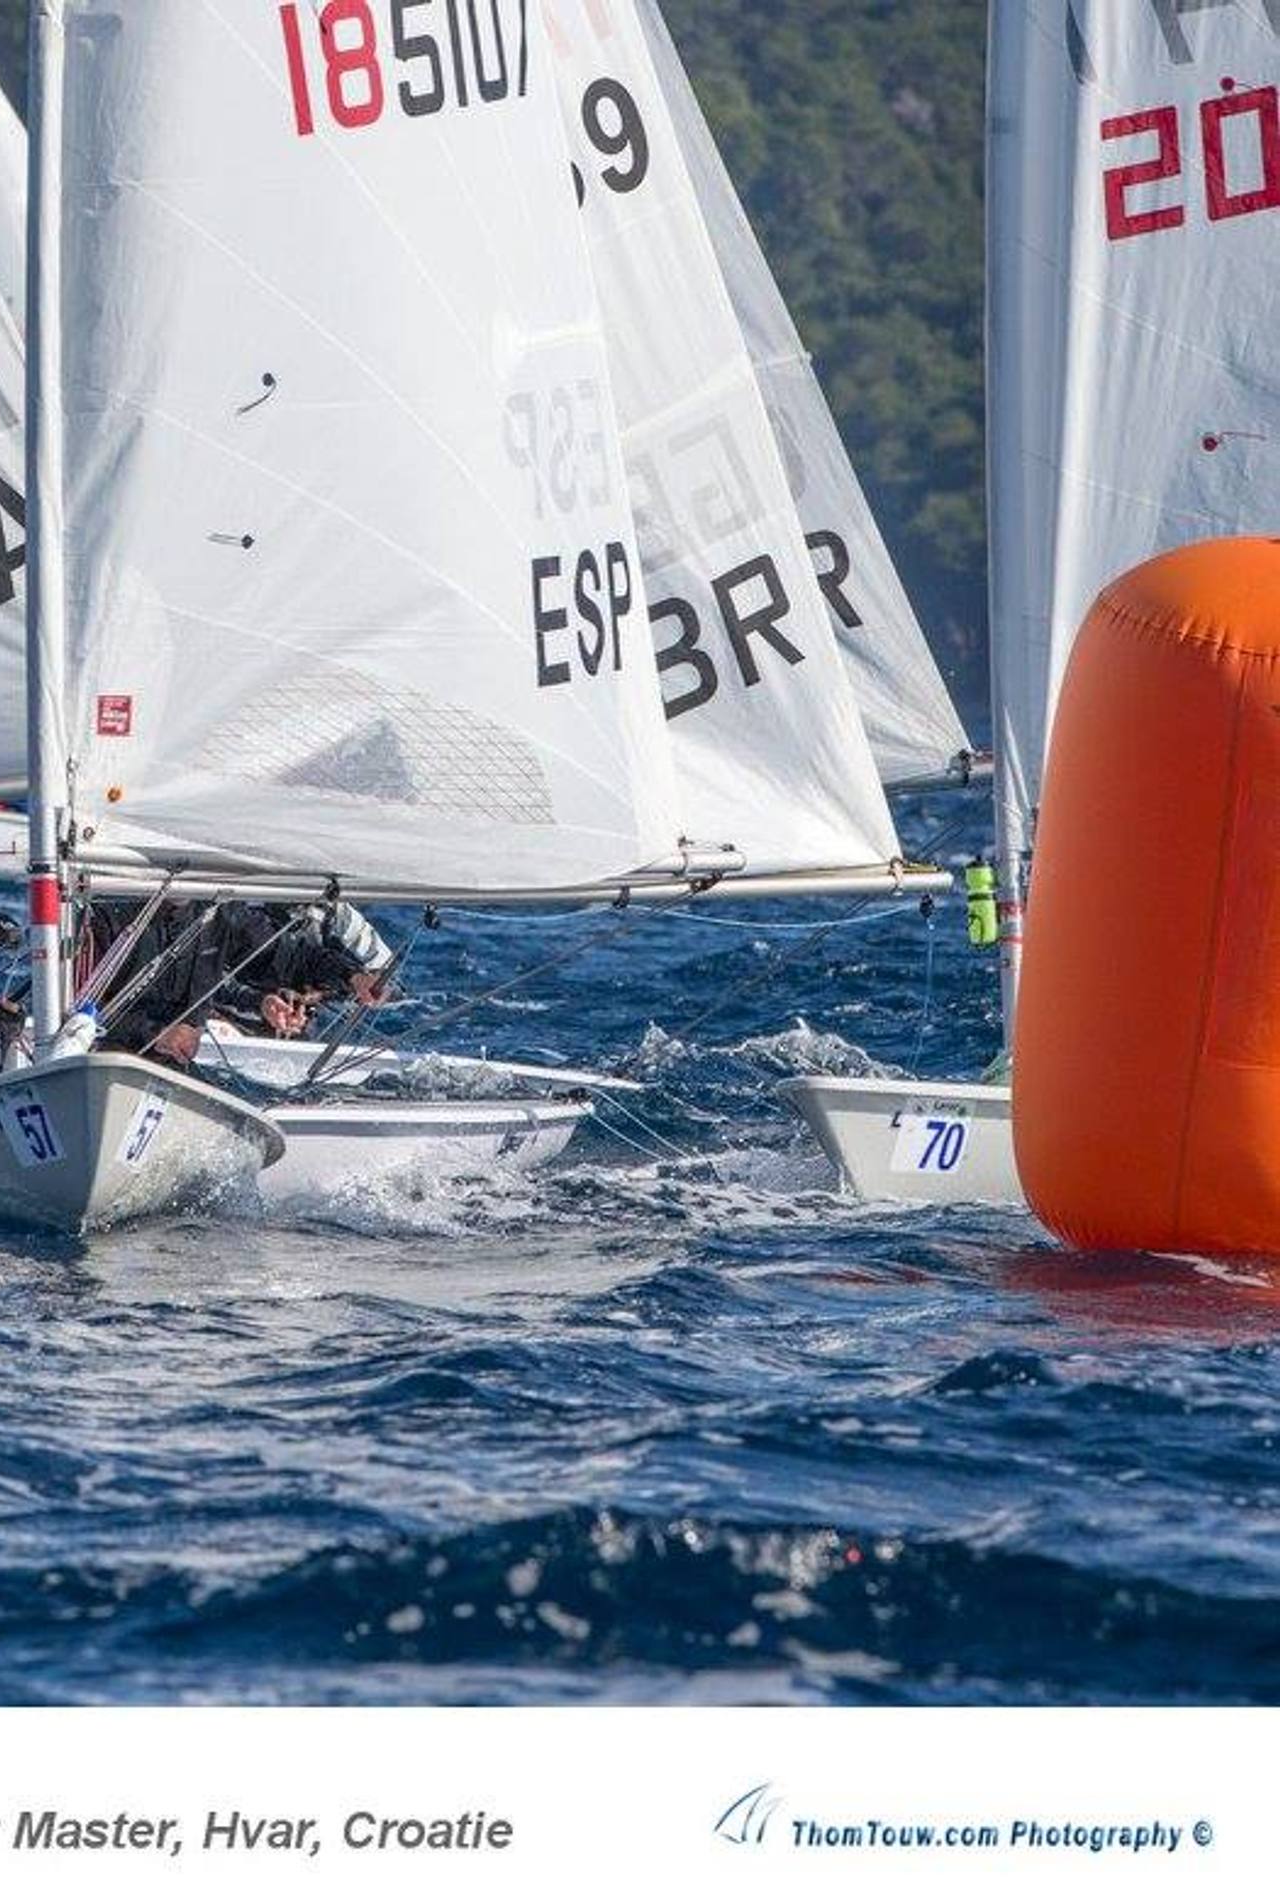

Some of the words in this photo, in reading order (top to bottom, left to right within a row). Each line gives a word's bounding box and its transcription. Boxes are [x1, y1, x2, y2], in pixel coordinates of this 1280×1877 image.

[1100, 86, 1280, 241] 20
[531, 541, 633, 687] ESP
[15, 1103, 58, 1161] 57
[918, 1121, 965, 1171] 70
